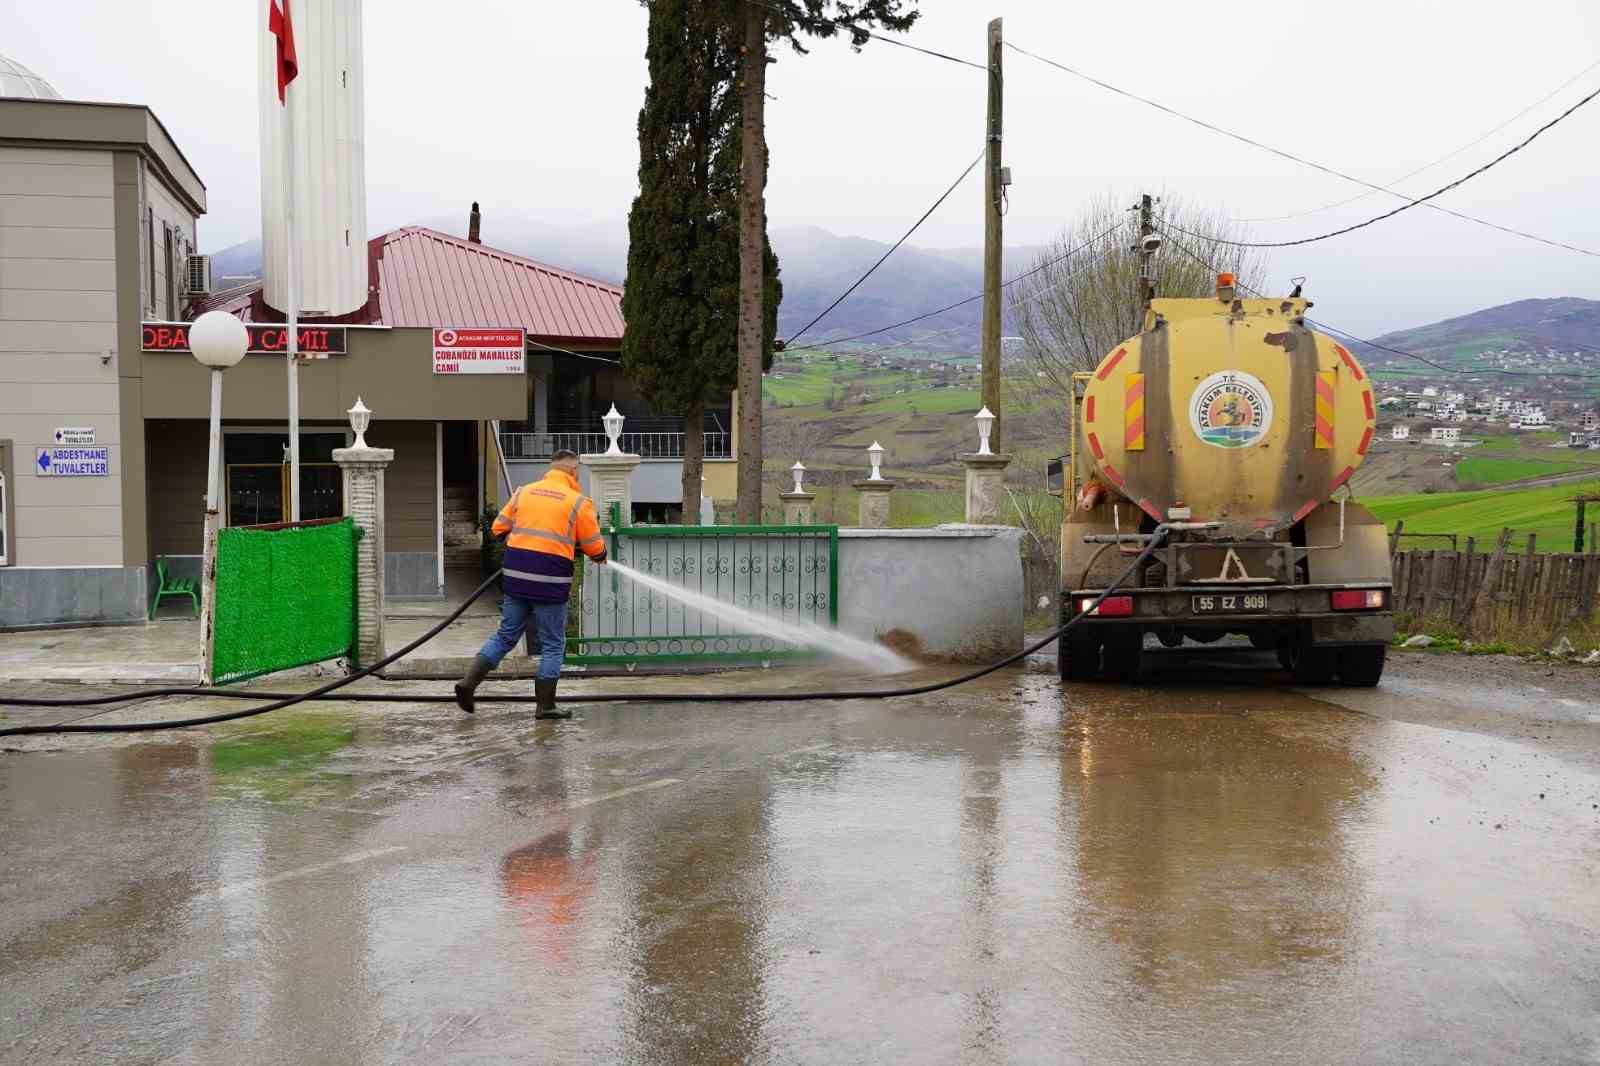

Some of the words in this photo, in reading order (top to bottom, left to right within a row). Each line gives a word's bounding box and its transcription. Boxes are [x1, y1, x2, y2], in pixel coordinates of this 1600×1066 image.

[1200, 389, 1222, 428] ATAKUM
[53, 450, 106, 460] ABDESTHANE
[53, 463, 106, 473] TUVALETLER
[1200, 597, 1214, 610] 55
[1222, 596, 1236, 609] EZ
[1244, 596, 1264, 609] 909
